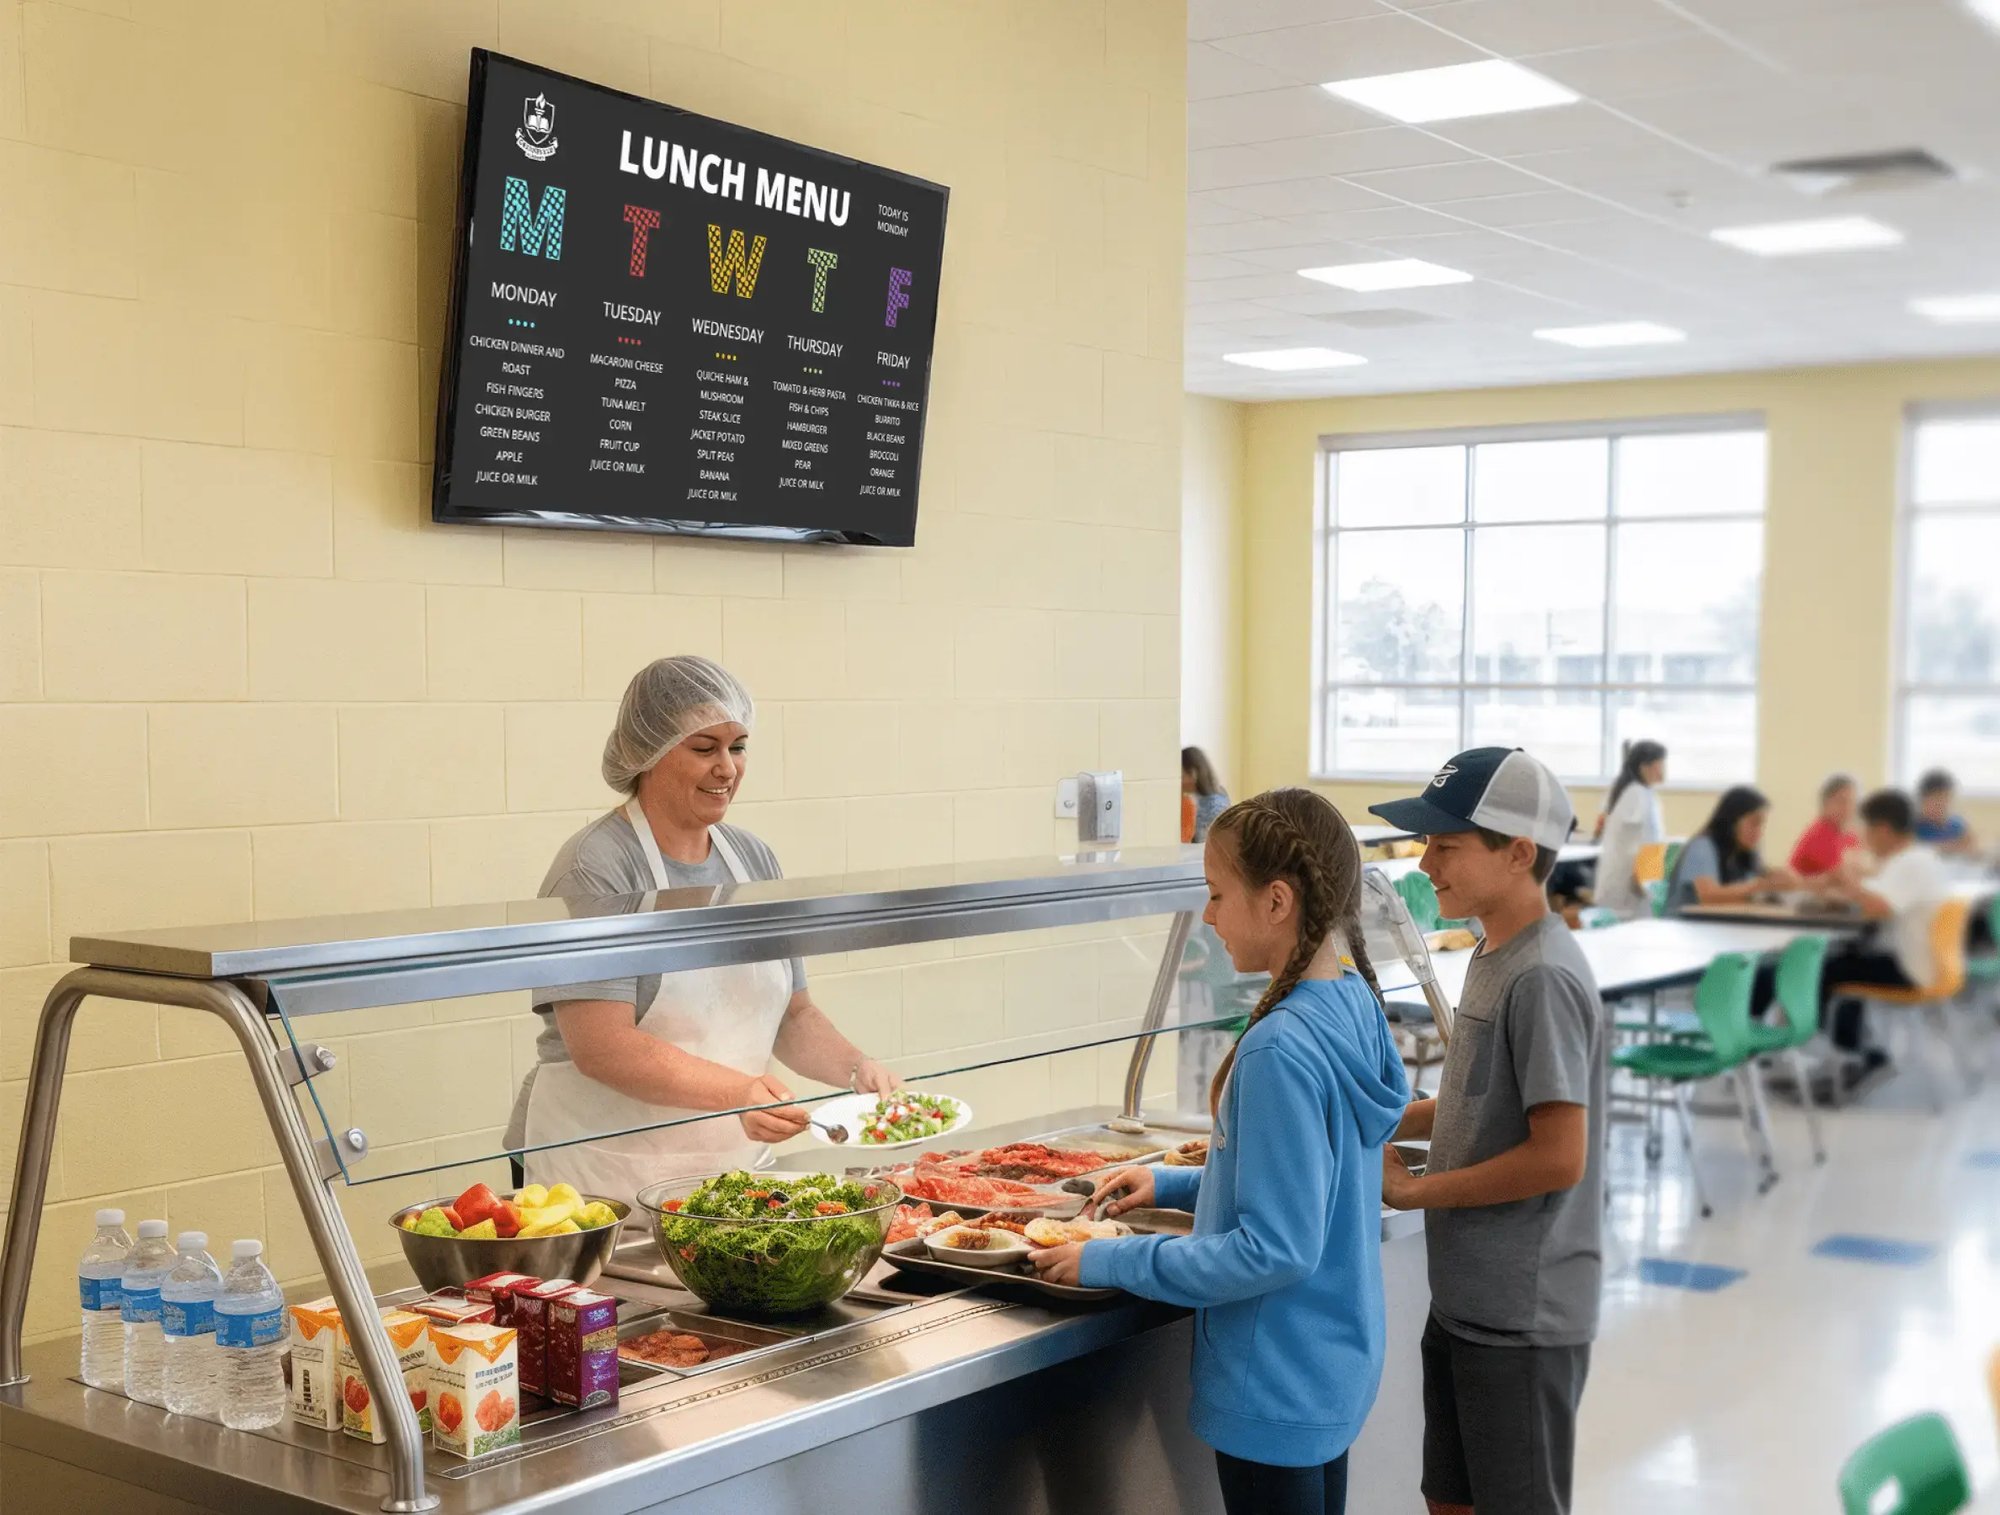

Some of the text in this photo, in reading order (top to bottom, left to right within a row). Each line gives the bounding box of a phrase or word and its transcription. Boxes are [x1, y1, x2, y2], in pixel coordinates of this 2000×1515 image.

[620, 130, 850, 226] LUNCH MENU
[500, 176, 566, 260] M
[878, 204, 901, 220] TODAY
[877, 220, 908, 237] MONDAY
[624, 205, 660, 277] T
[708, 224, 767, 298] W
[807, 248, 838, 313] T
[491, 282, 557, 307] MONDAY
[886, 267, 911, 327] F
[604, 302, 661, 325] TUESDAY
[692, 318, 764, 343] WEDNESDAY
[470, 336, 564, 358] CHICKEN DINNER AND
[788, 335, 843, 357] THURSDAY
[590, 354, 663, 373] MACARONI CHEESE
[877, 351, 910, 369] FRIDAY
[502, 362, 531, 375] ROAST
[615, 378, 636, 389] PIZZA
[697, 370, 724, 384] QUICHE
[725, 374, 742, 384] HAM
[487, 382, 543, 399] FISH FINGERS
[701, 390, 743, 404] MUSHROOM
[773, 381, 801, 393] TOMATO
[809, 387, 826, 397] HERB
[827, 389, 846, 400] PASTA
[602, 397, 645, 411] TUNA MELT
[789, 402, 804, 412] FISH
[810, 405, 829, 416] CHIPS
[857, 394, 883, 406] CHICKEN
[884, 398, 900, 408] TIKKA
[906, 402, 919, 411] RICE
[475, 403, 550, 422] CHICKEN BURGER
[700, 410, 740, 424] STEAK SLICE
[610, 419, 631, 431] CORN
[875, 415, 900, 425] BURRITO
[480, 426, 539, 442] GREEN BEANS
[787, 422, 827, 434] HAMBURGER
[690, 429, 745, 444] JACKET POTATO
[867, 432, 906, 444] BLACK BEANS
[600, 439, 640, 451] FRUIT CUP
[782, 440, 828, 453] MIXED GREENS
[496, 451, 522, 462] APPLE
[697, 449, 734, 462] SPLIT PEAS
[870, 450, 898, 461] BROCCOLI
[589, 460, 611, 471] JUICE
[626, 463, 644, 473] MILK
[795, 460, 811, 469] PEAR
[475, 471, 499, 483] JUICE
[517, 474, 537, 485] MILK
[700, 470, 729, 481] BANANA
[870, 468, 895, 478] ORANGE
[778, 477, 797, 488] JUICE
[808, 480, 824, 489] MILK
[687, 489, 708, 499] JUICE
[721, 491, 738, 501] MILK
[860, 486, 877, 495] JUICE
[886, 488, 901, 496] MILK
